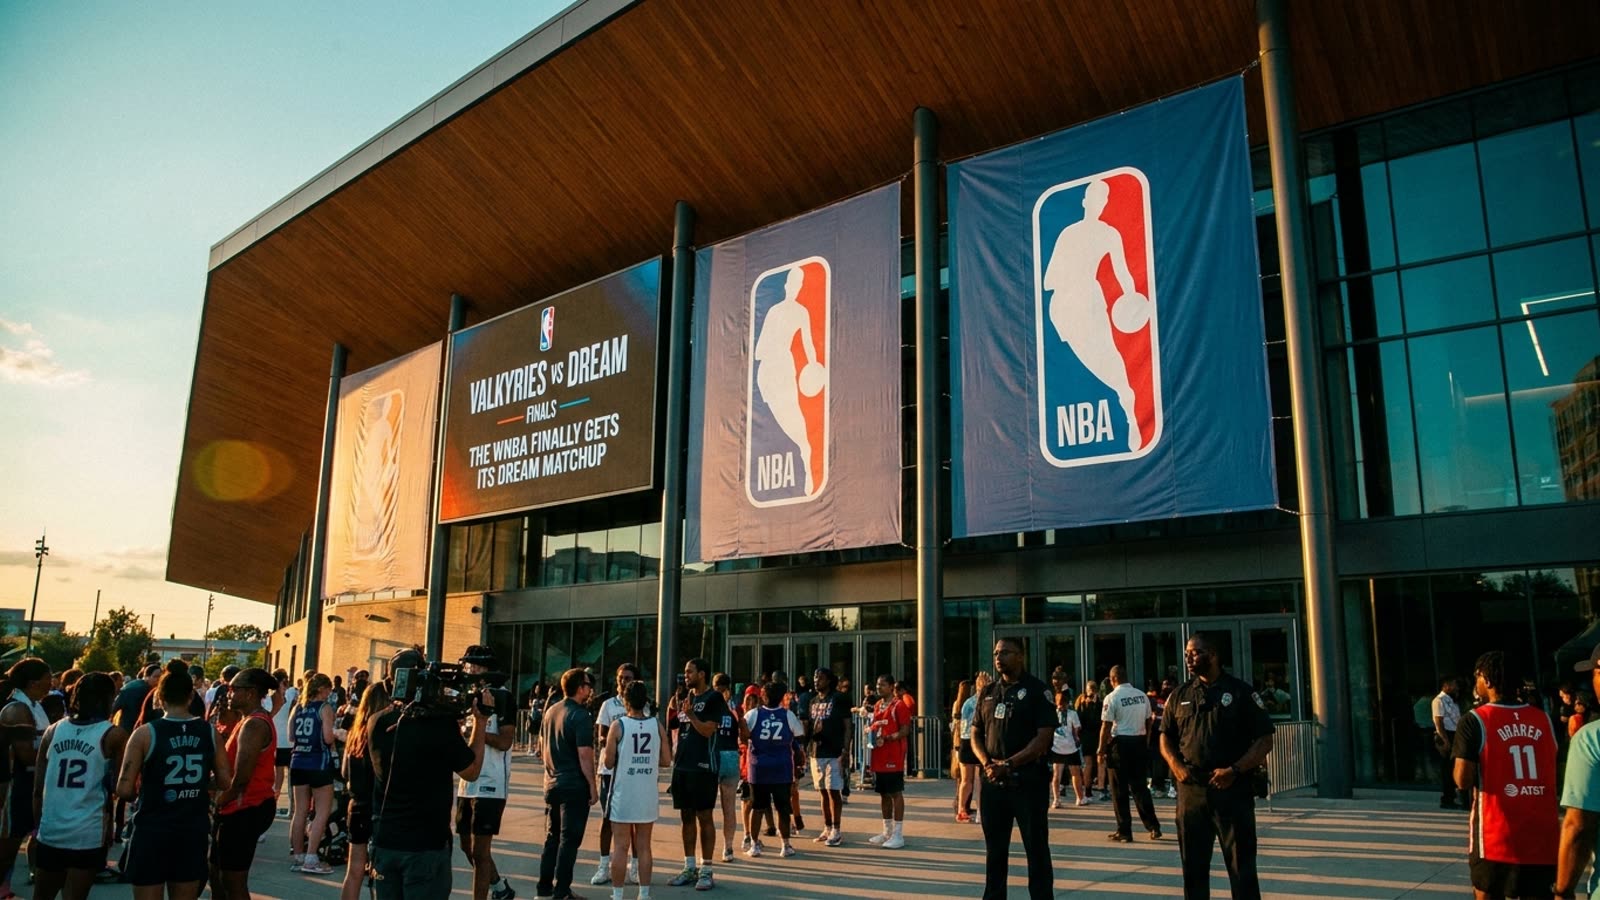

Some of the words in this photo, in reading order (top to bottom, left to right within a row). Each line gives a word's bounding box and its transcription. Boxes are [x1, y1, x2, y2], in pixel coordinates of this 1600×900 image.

[470, 360, 547, 415] VALKYRIES
[567, 334, 628, 388] DREAM
[526, 400, 557, 424] FINALS
[1056, 398, 1115, 448] NBA
[469, 443, 491, 468] THE
[493, 435, 528, 462] WNBA
[531, 421, 582, 455] FINALLY
[584, 412, 620, 440] GETS
[477, 467, 495, 489] ITS
[497, 455, 540, 485] DREAM
[542, 443, 607, 477] MATCHUP
[757, 451, 796, 492] NBA
[631, 732, 651, 754] 12
[57, 758, 88, 788] 12
[164, 754, 203, 785] 25
[1509, 745, 1538, 780] 11
